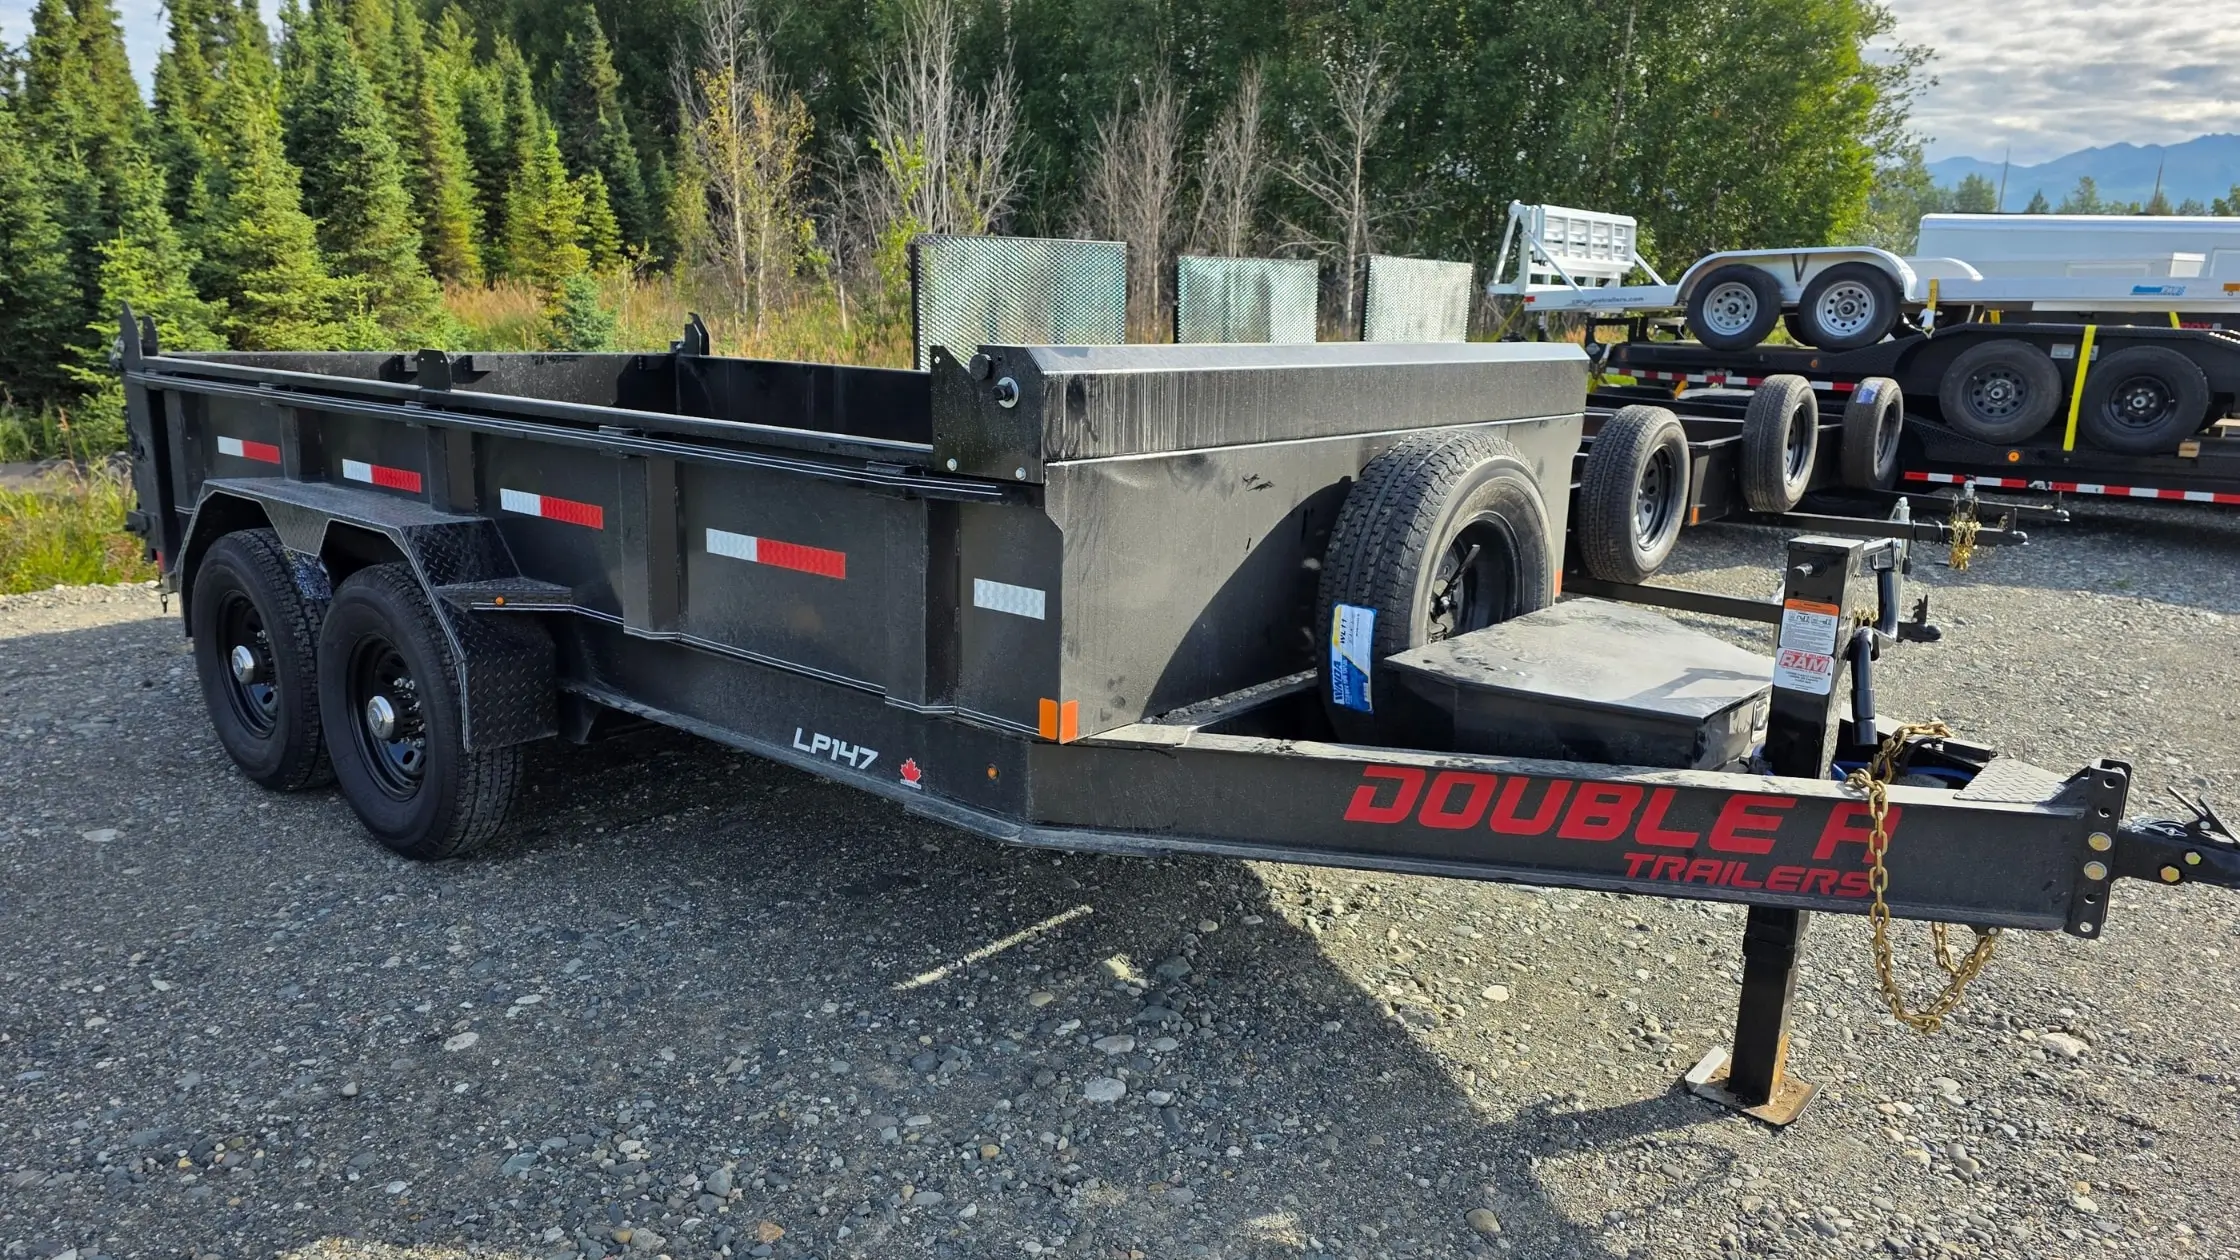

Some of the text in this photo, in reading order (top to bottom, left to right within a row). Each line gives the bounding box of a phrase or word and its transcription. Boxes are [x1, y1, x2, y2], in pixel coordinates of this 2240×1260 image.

[1333, 660, 1344, 701] WINDA
[1779, 653, 1829, 673] RAM
[792, 727, 878, 770] LP147
[1343, 765, 1903, 864] DOUBLE A
[1623, 852, 1872, 898] TRAILERS
